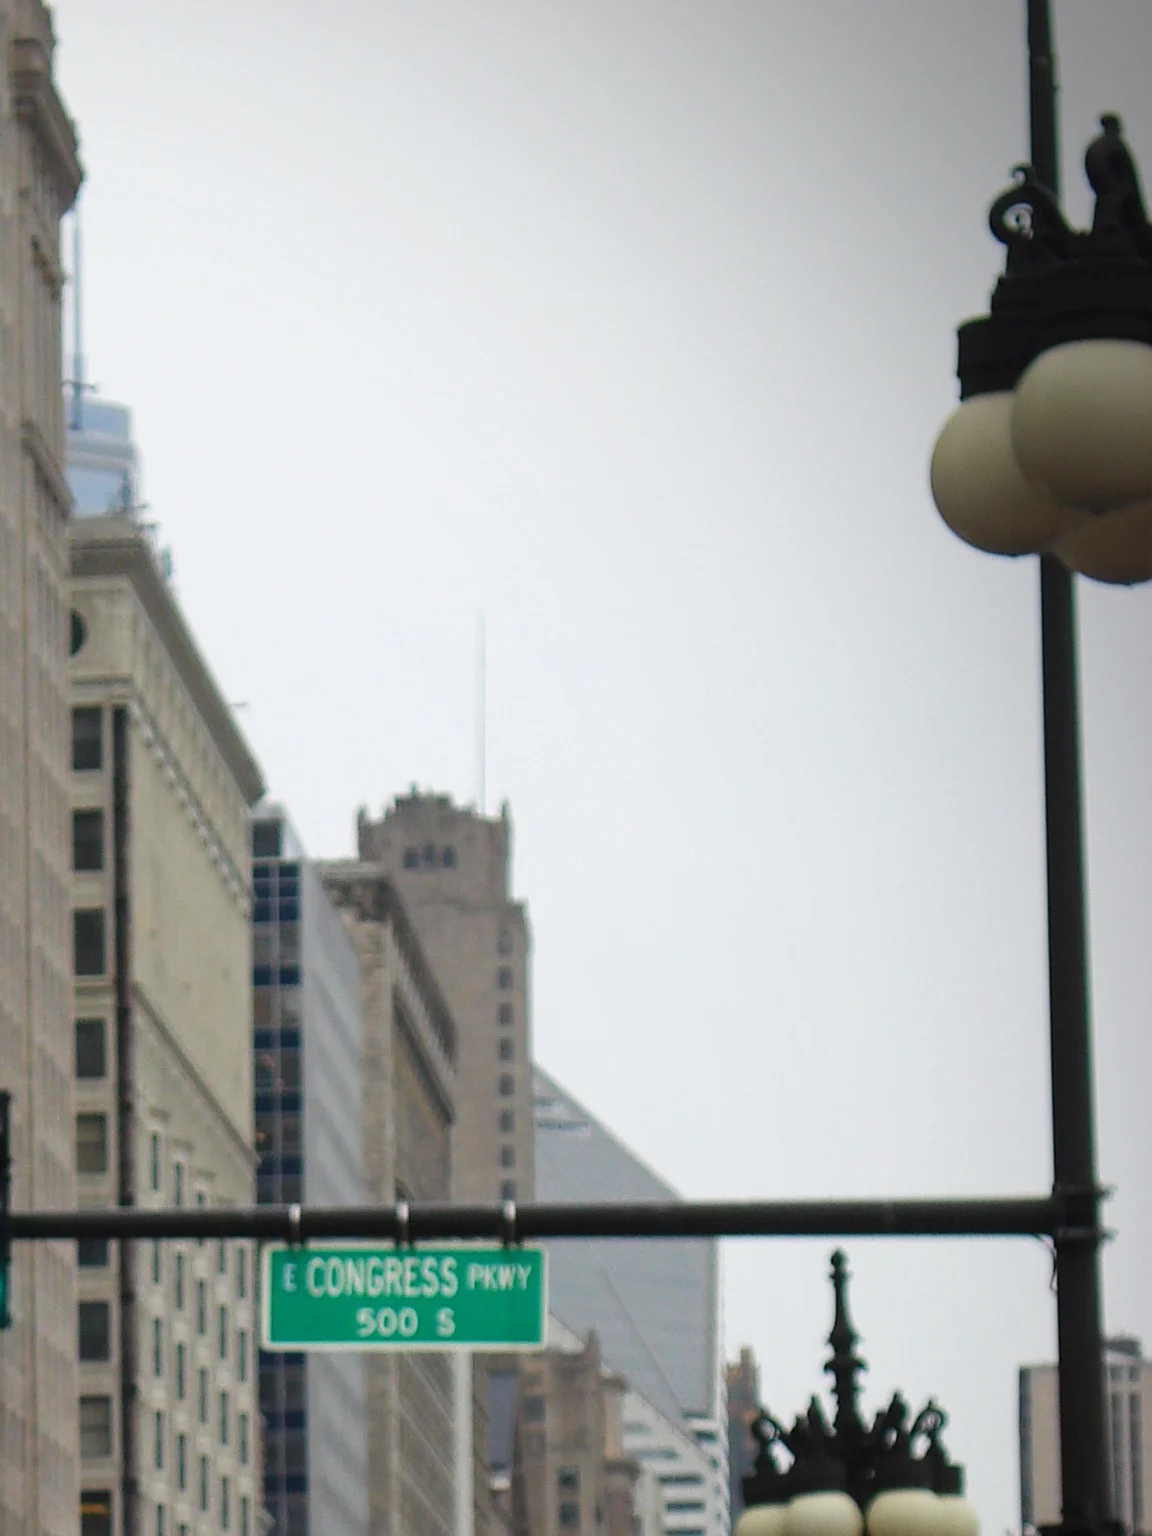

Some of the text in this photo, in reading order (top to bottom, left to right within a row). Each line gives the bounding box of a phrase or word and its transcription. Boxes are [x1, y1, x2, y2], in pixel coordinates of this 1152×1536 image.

[282, 1257, 531, 1298] E CONGRESS PKWY
[356, 1307, 455, 1337] 500 S
